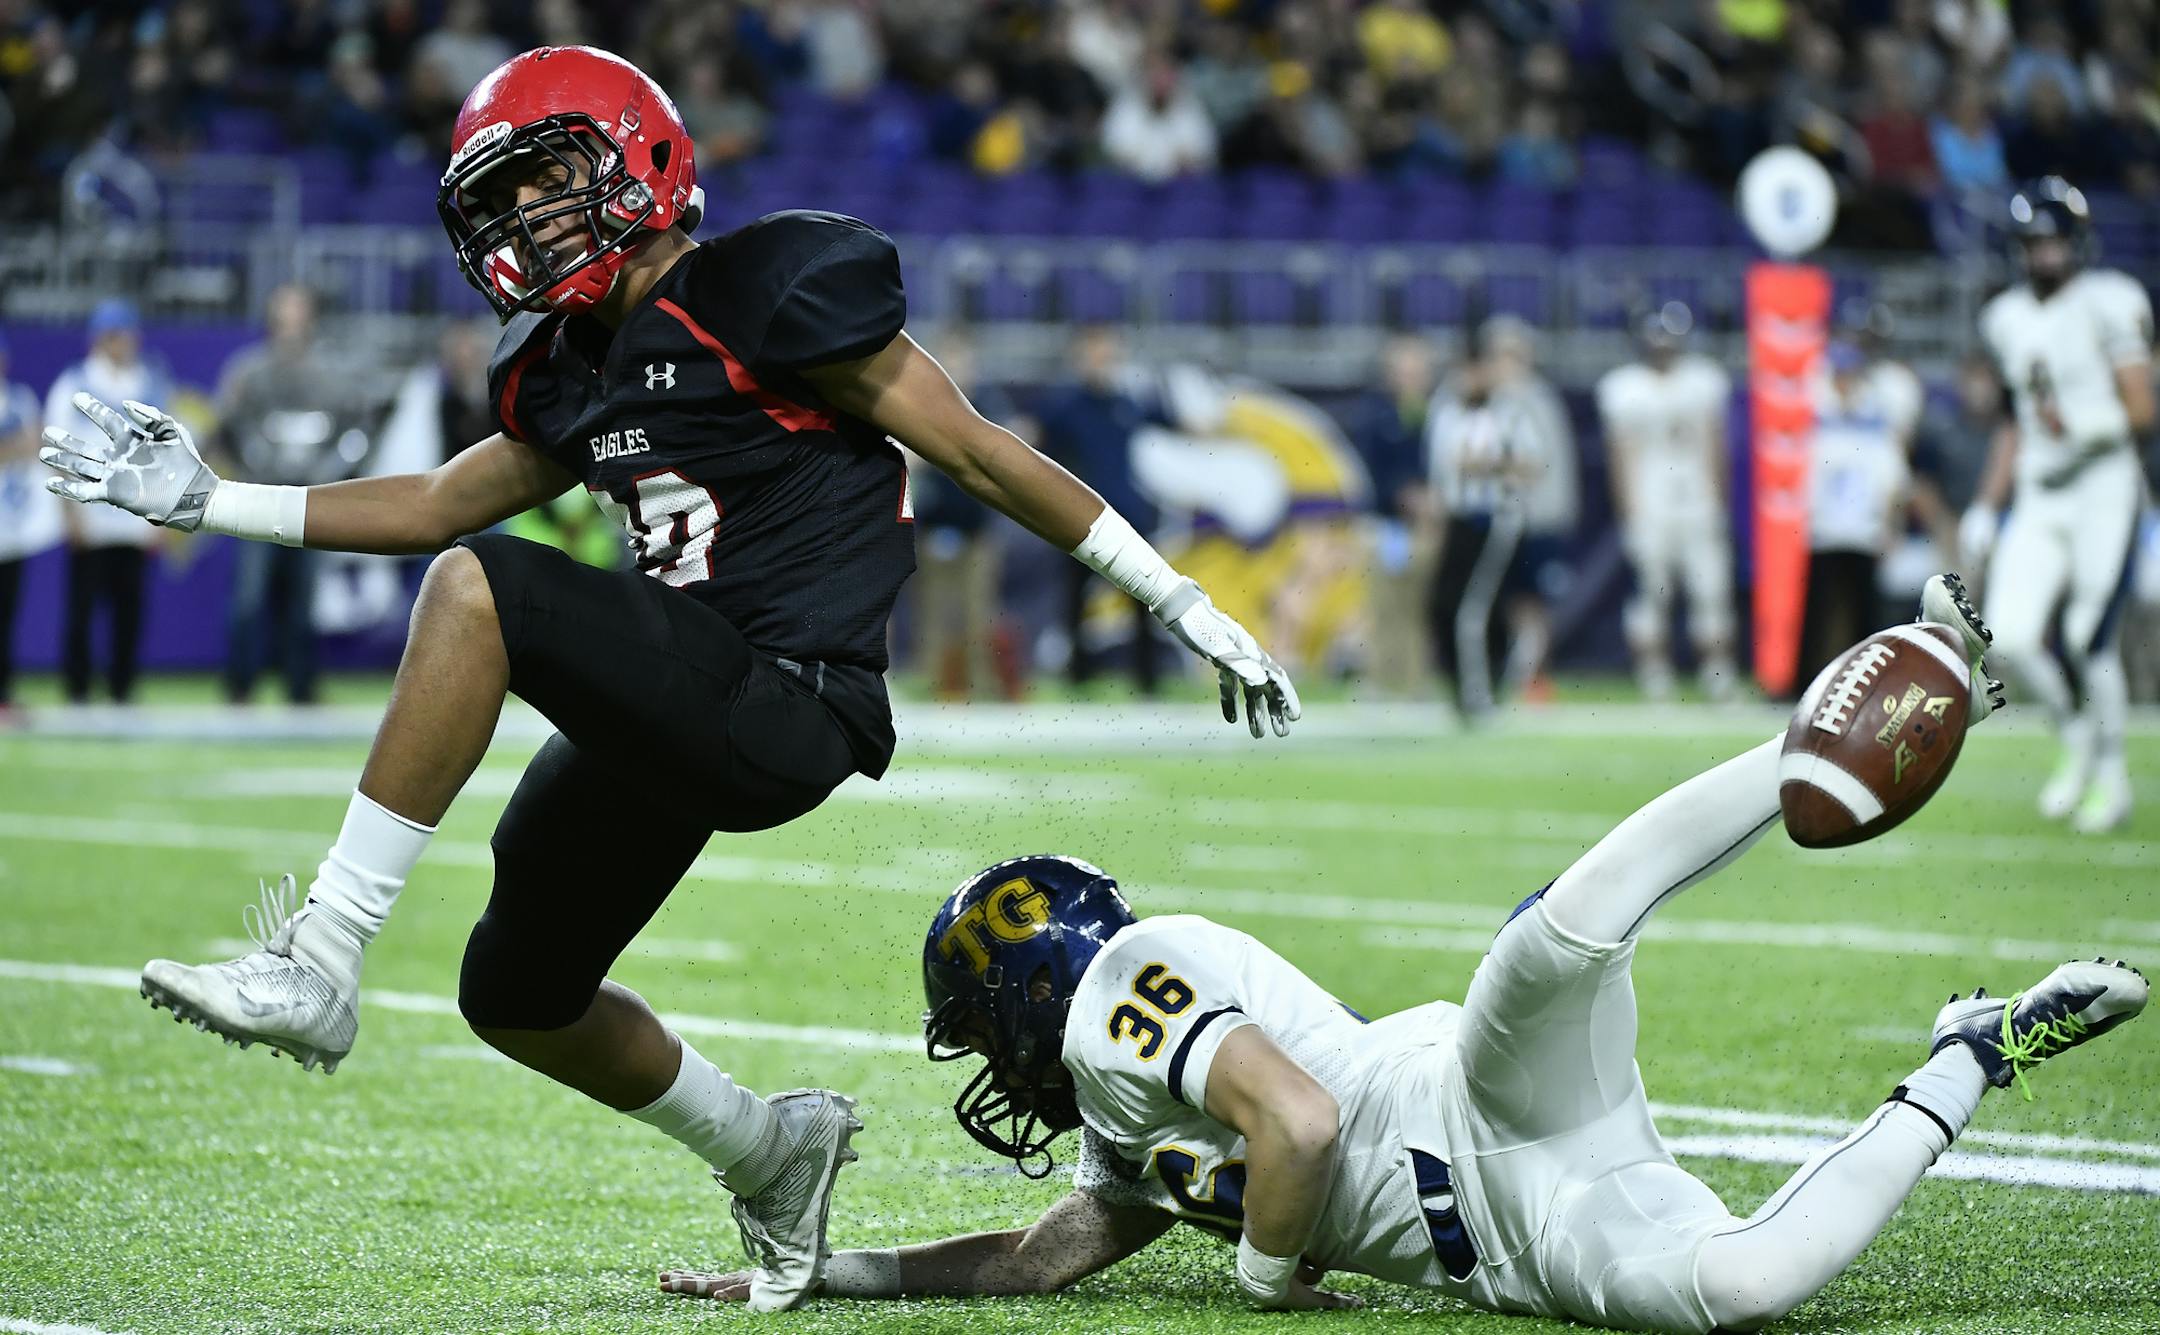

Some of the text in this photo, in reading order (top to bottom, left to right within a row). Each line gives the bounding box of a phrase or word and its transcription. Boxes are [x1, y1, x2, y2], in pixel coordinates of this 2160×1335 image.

[462, 128, 495, 158] Riddell
[588, 428, 651, 463] EAGLES
[940, 876, 1051, 976] TG
[1106, 961, 1197, 1064] 36
